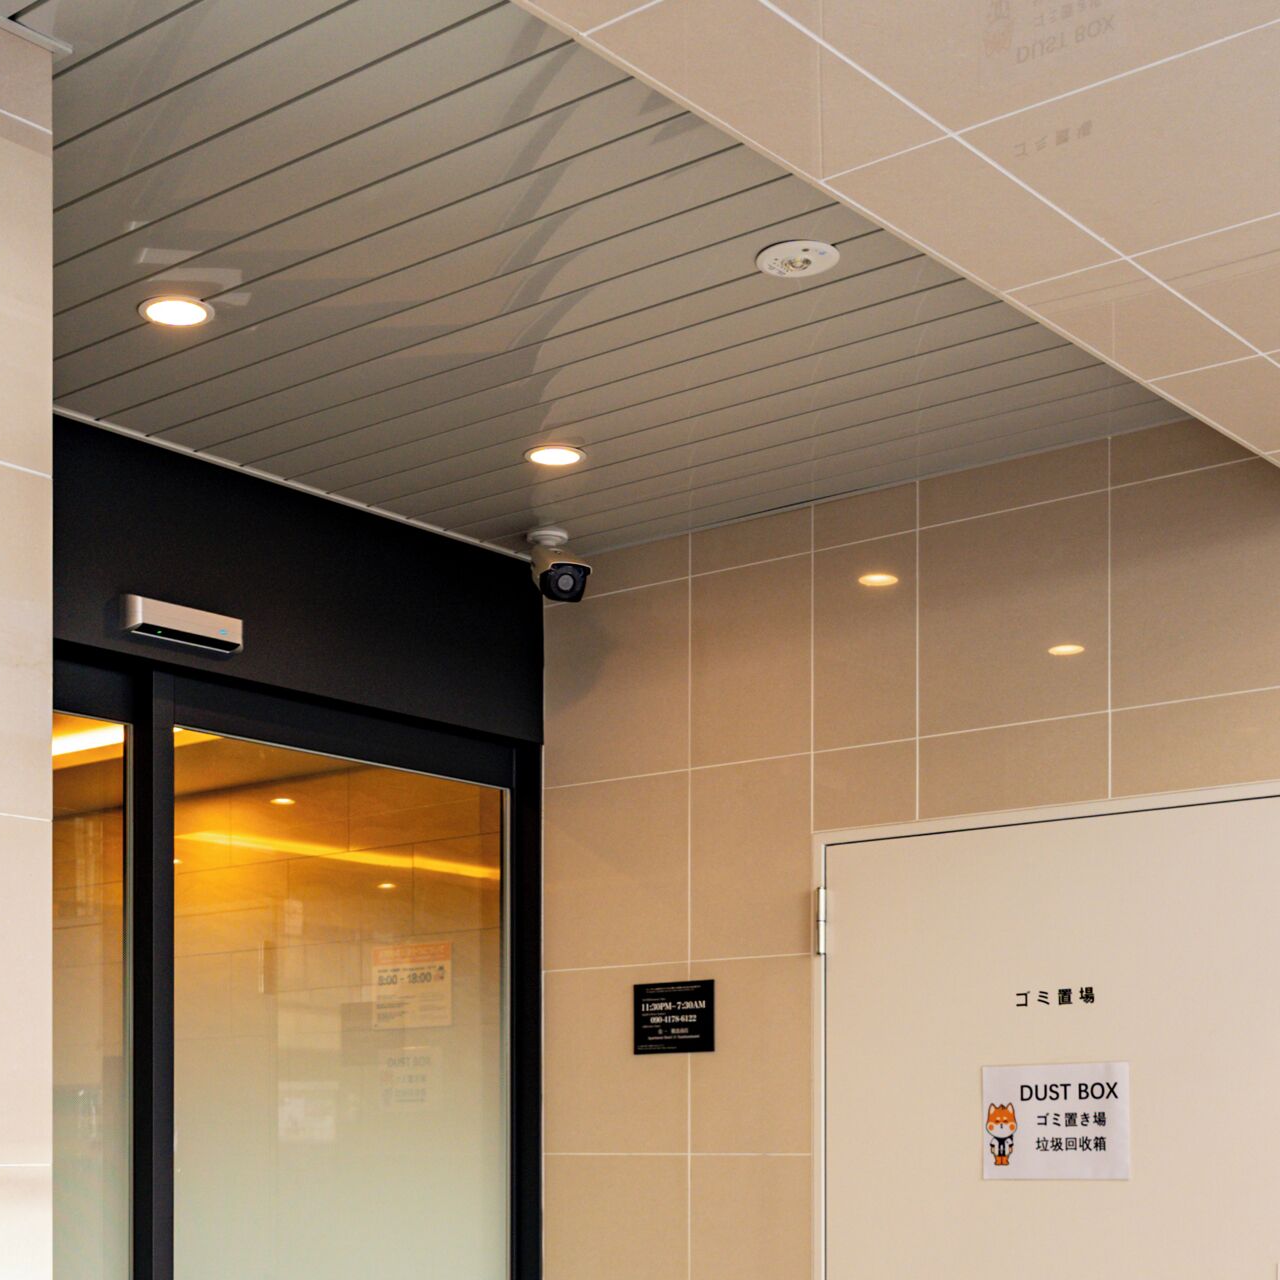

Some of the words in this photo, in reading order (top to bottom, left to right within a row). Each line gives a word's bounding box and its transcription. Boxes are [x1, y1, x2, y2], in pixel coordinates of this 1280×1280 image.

[1015, 986, 1095, 1008] ゴミ置場
[1020, 1083, 1072, 1102] DUST
[1077, 1081, 1119, 1100] BOX
[1036, 1111, 1107, 1128] ゴミ置き場
[1035, 1136, 1107, 1152] 垃圾回收箱
